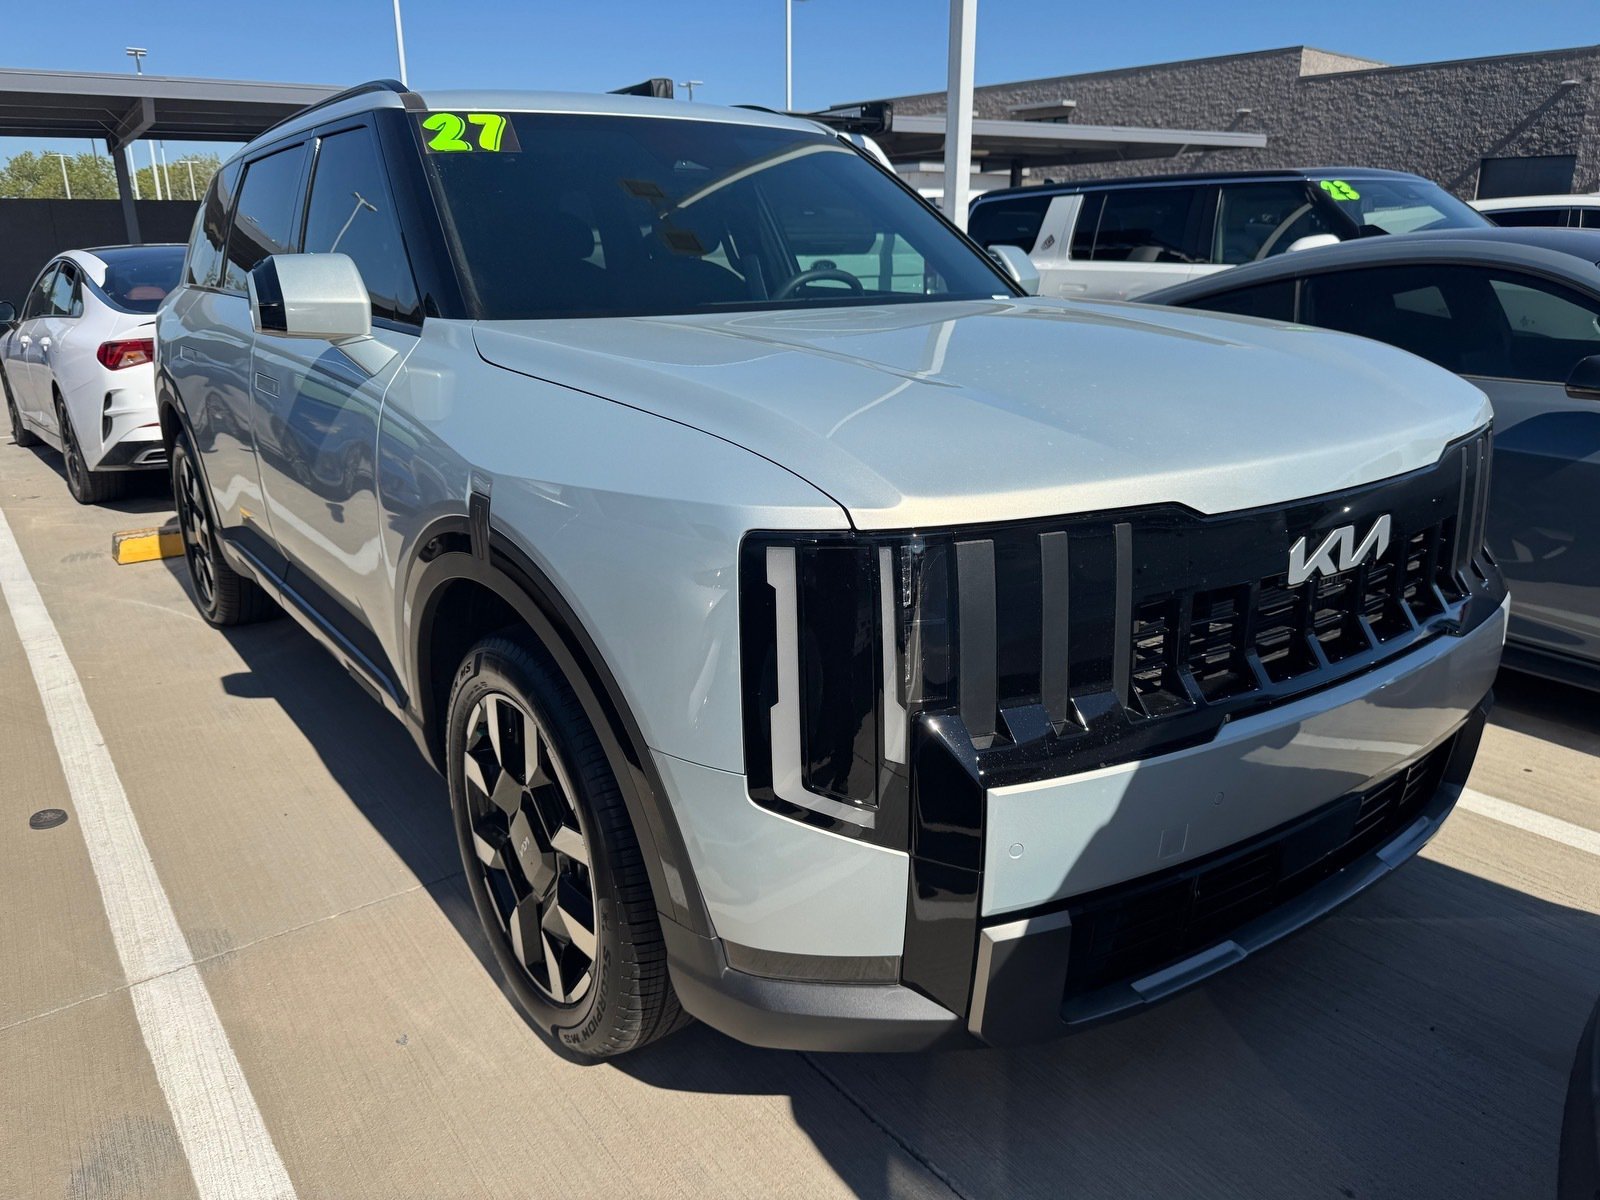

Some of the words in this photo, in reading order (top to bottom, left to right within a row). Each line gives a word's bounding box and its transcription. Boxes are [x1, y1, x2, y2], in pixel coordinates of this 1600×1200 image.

[422, 112, 507, 152] 27
[1320, 180, 1360, 201] 23
[1287, 513, 1392, 585] KIA
[581, 945, 611, 1041] SCORPION
